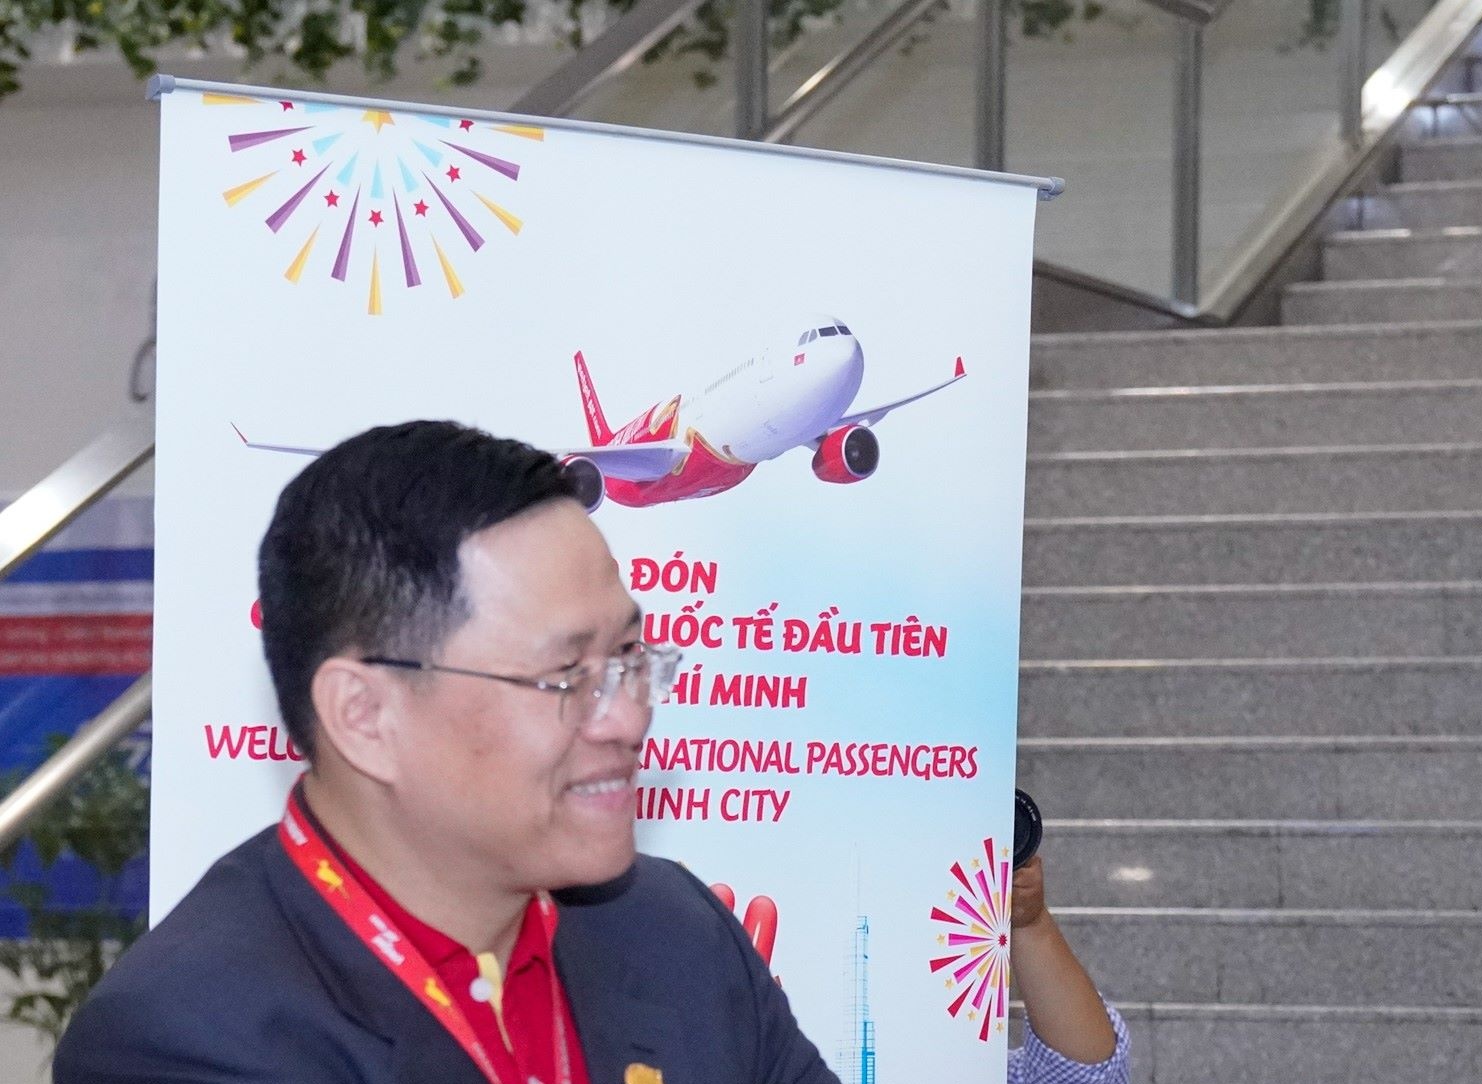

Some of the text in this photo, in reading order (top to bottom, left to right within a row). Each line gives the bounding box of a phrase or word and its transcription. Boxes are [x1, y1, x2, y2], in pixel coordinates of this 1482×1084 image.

[630, 551, 717, 594] ĐÓN
[643, 600, 947, 657] UỐC TẾ ĐẦU TIÊN
[709, 673, 807, 709] MINH
[638, 737, 800, 774] NATIONAL
[807, 742, 978, 780] PASSENGERS
[720, 788, 790, 822] CITY
